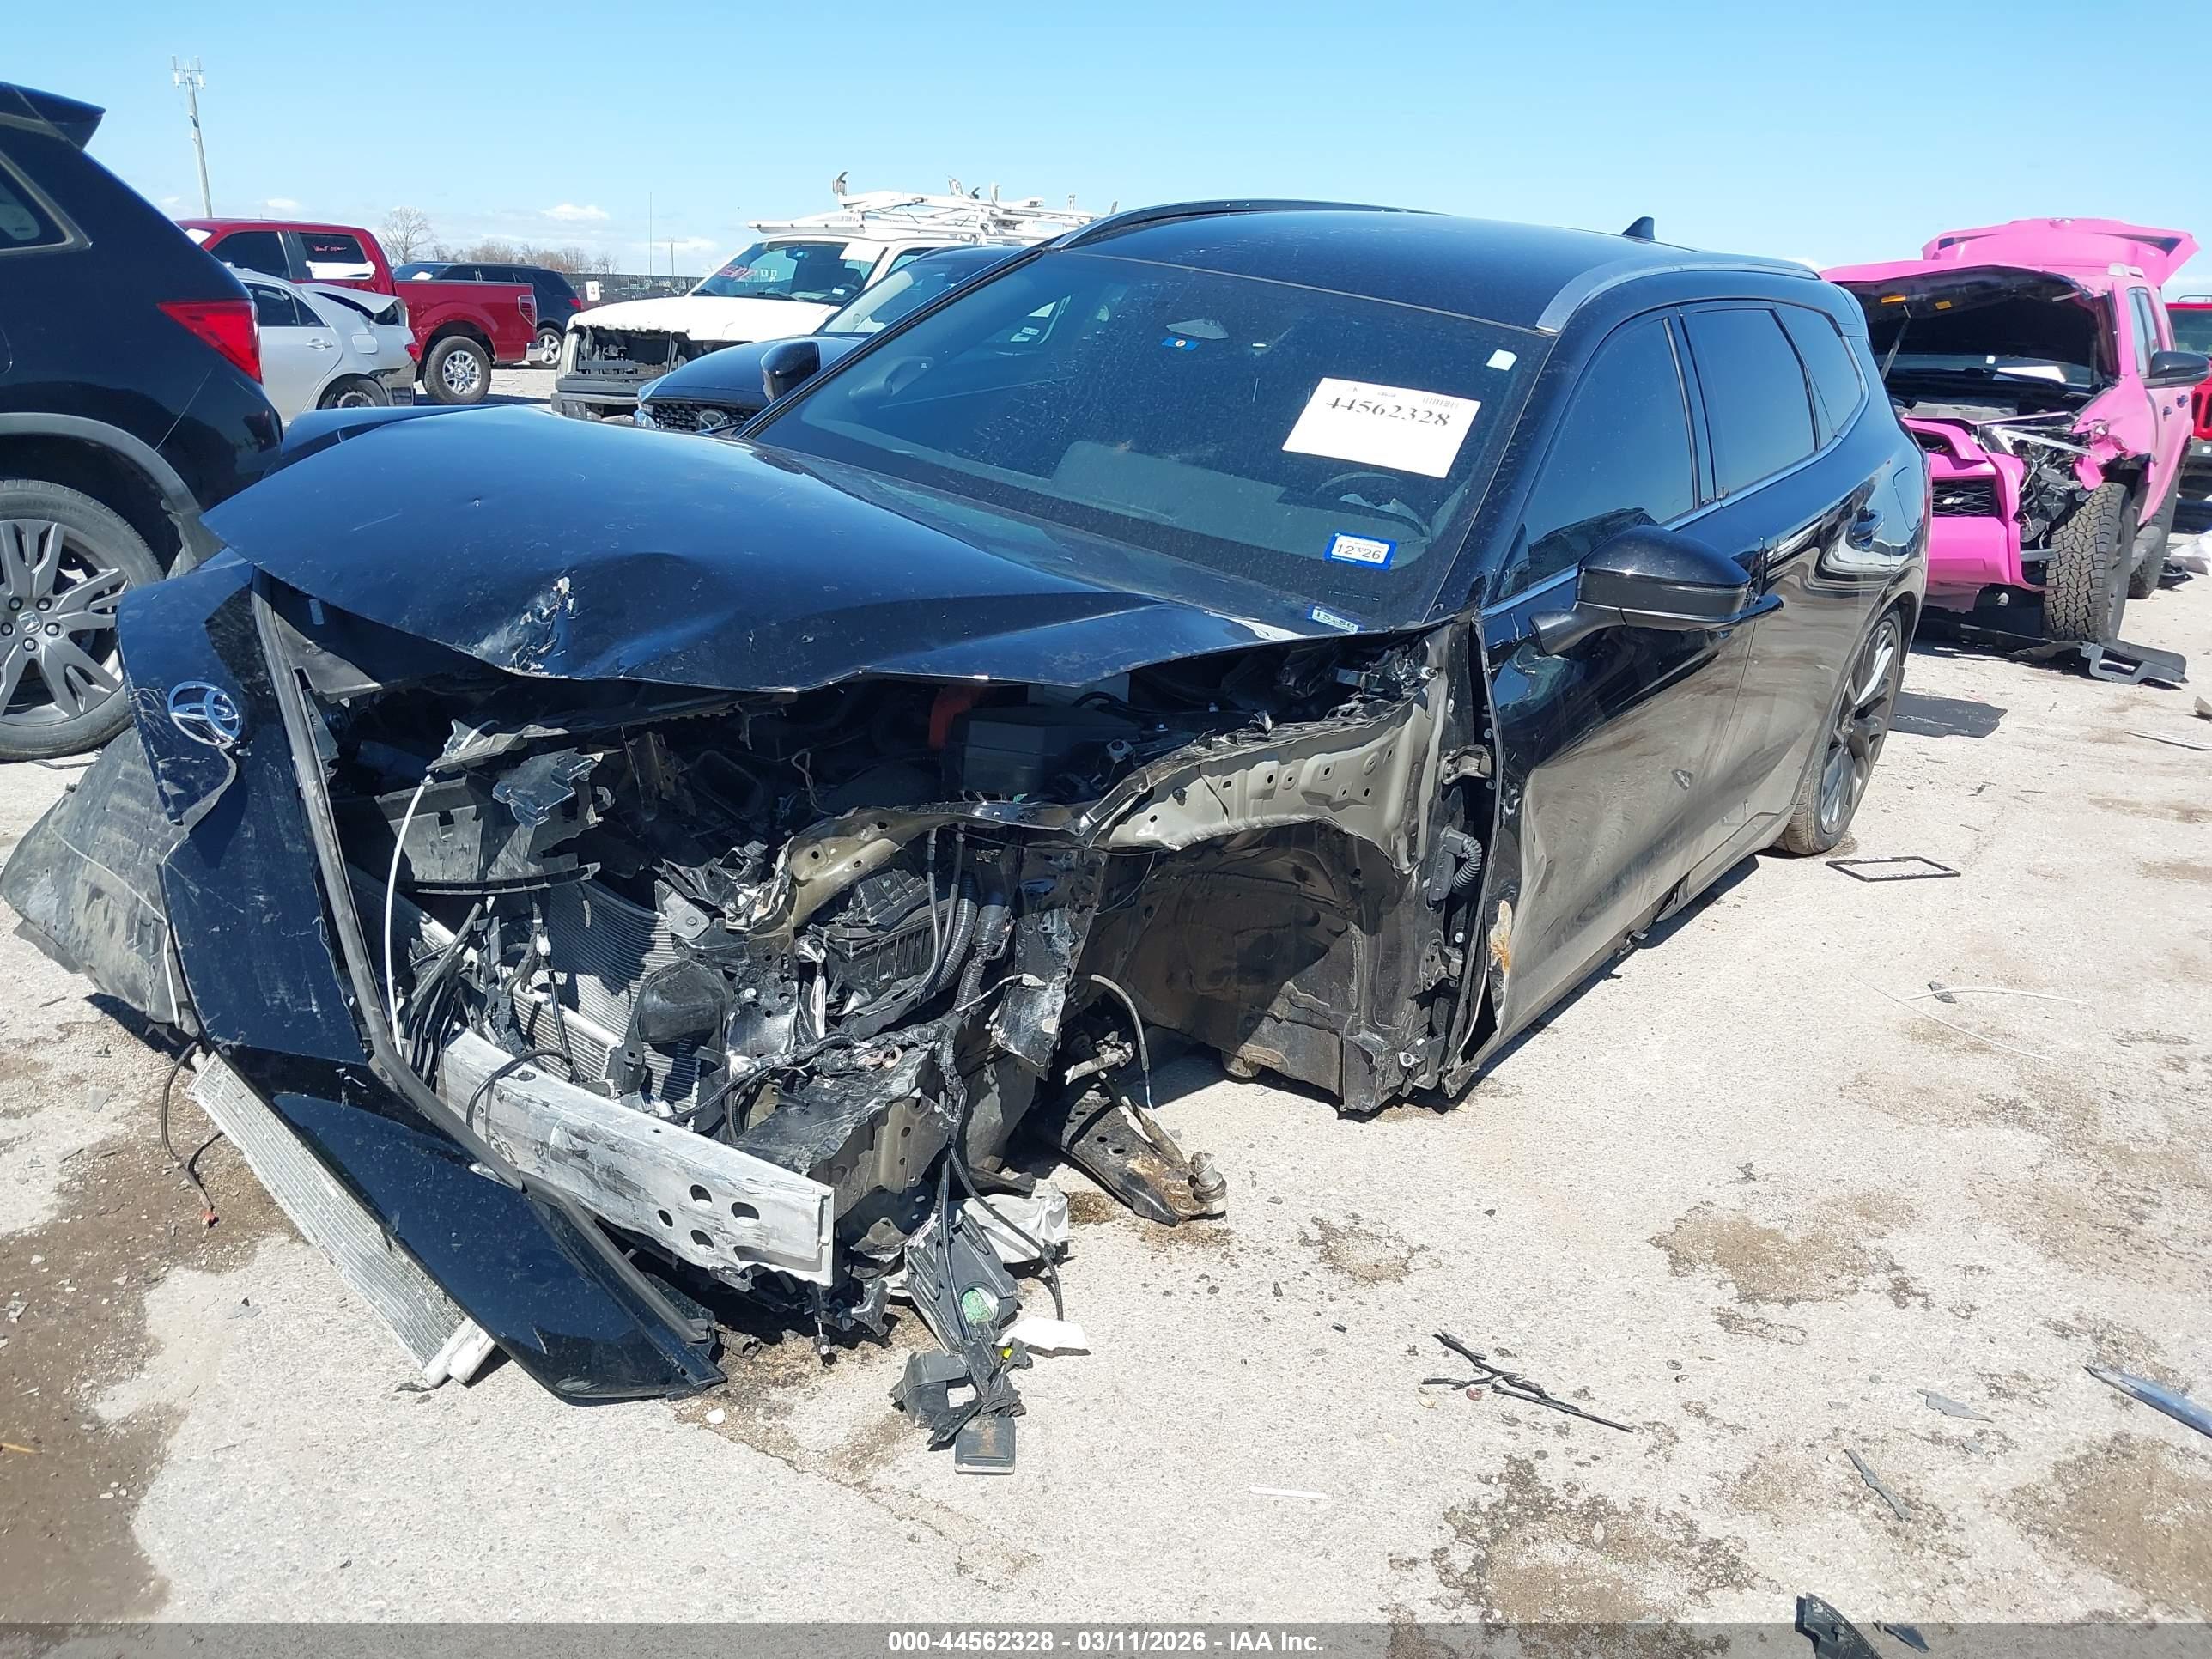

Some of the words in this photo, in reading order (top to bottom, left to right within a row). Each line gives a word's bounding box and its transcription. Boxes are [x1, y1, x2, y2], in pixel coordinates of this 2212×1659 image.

[1326, 397, 1450, 427] 44562328
[1337, 544, 1354, 555] 12
[1362, 549, 1382, 560] 26
